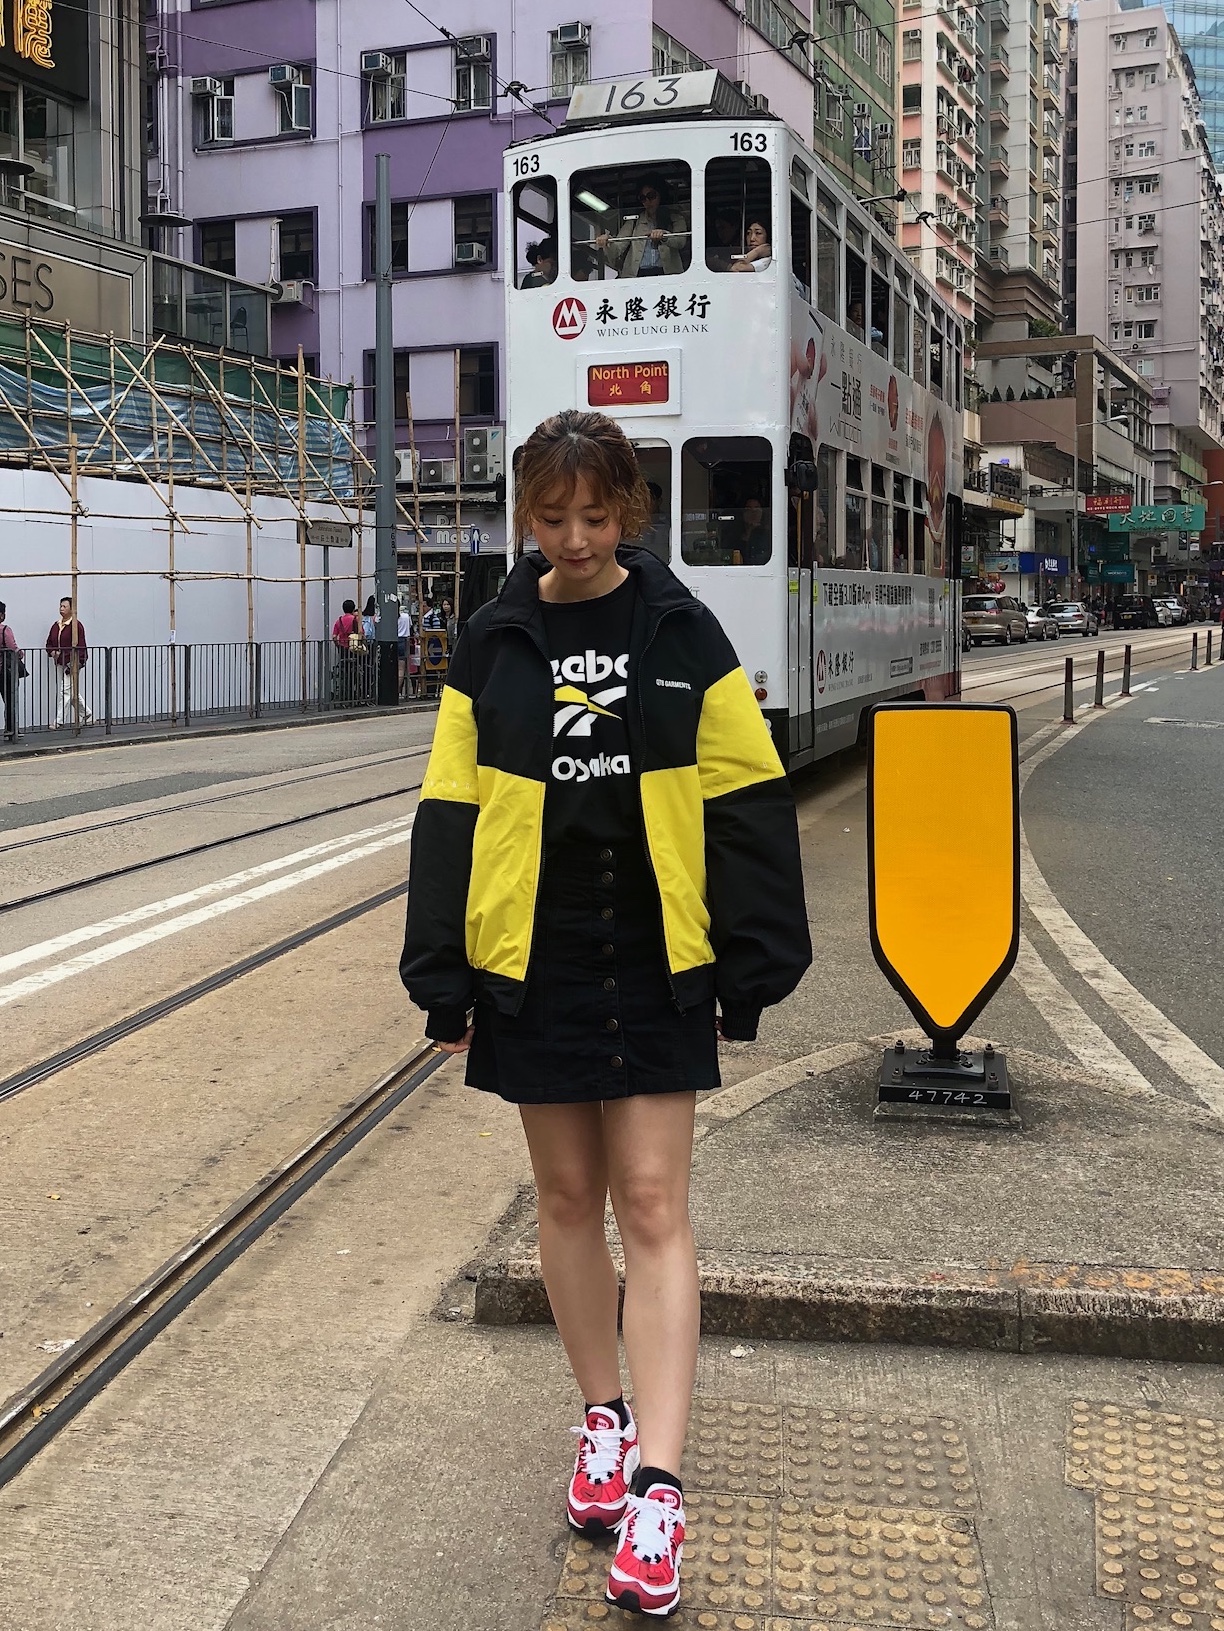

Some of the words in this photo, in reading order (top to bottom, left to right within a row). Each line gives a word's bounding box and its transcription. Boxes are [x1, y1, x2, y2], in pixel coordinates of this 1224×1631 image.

[604, 77, 682, 113] 163
[729, 132, 768, 152] 163
[513, 154, 540, 177] 163
[595, 293, 711, 325] 永隆銀行
[597, 328, 629, 337] WING
[634, 325, 668, 335] LUNG
[673, 323, 709, 334] BANK
[592, 366, 629, 380] North
[634, 364, 668, 378] Point
[551, 752, 631, 783] Osaka
[908, 1090, 988, 1105] 47742
